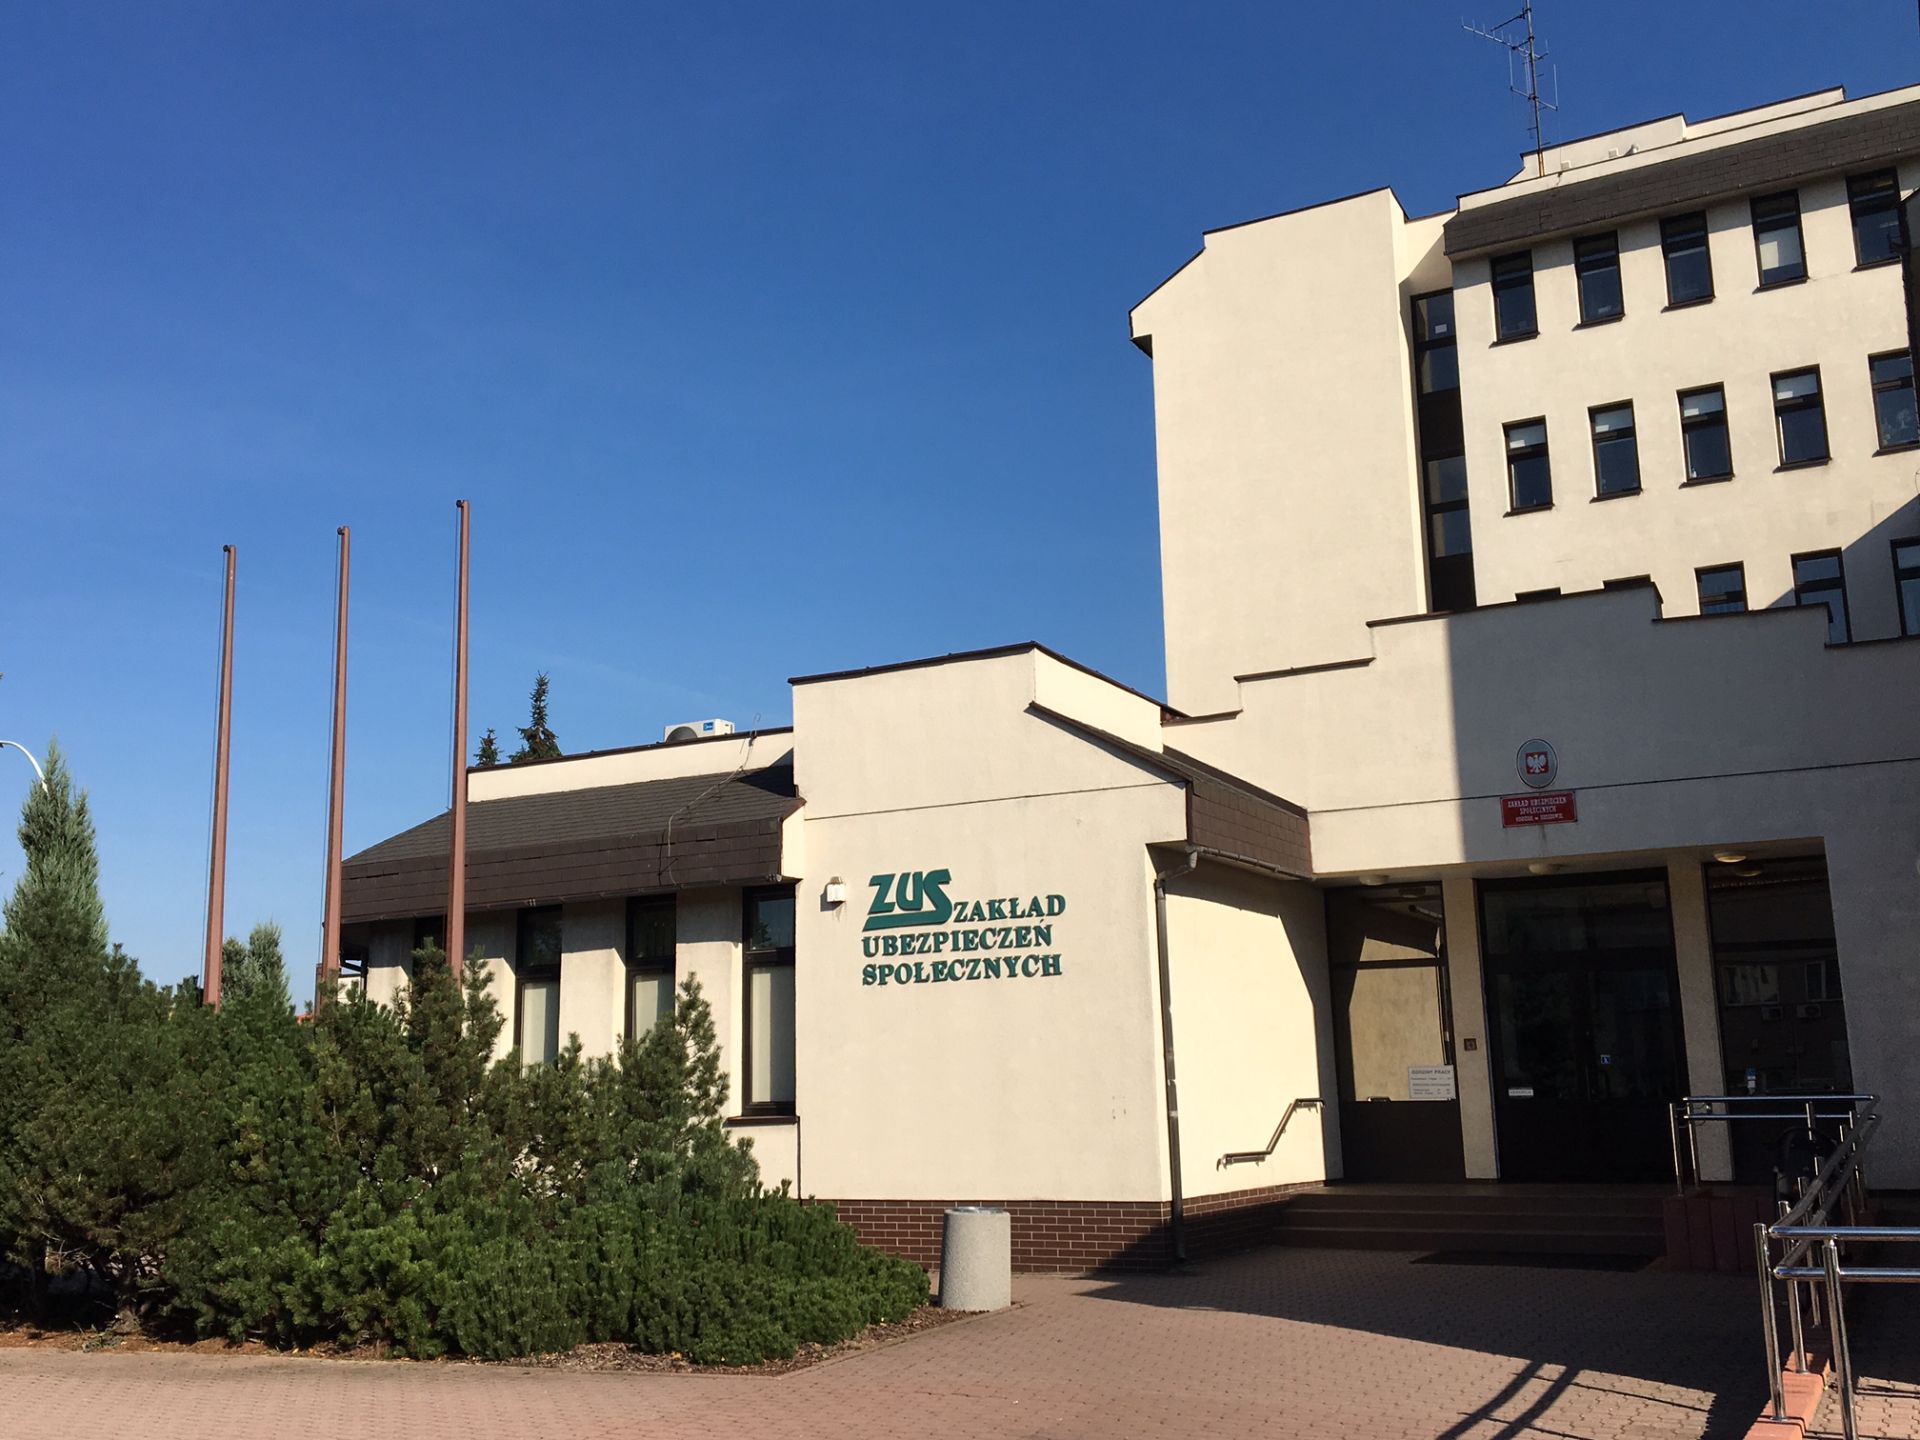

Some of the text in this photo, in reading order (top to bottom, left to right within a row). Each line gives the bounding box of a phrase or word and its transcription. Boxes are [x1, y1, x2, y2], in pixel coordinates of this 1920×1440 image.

[862, 868, 1066, 932] ZUS ZAKŁAD
[861, 918, 1053, 958] UBEZPIECZEŃ
[862, 953, 1063, 986] SPOŁECZNYCH
